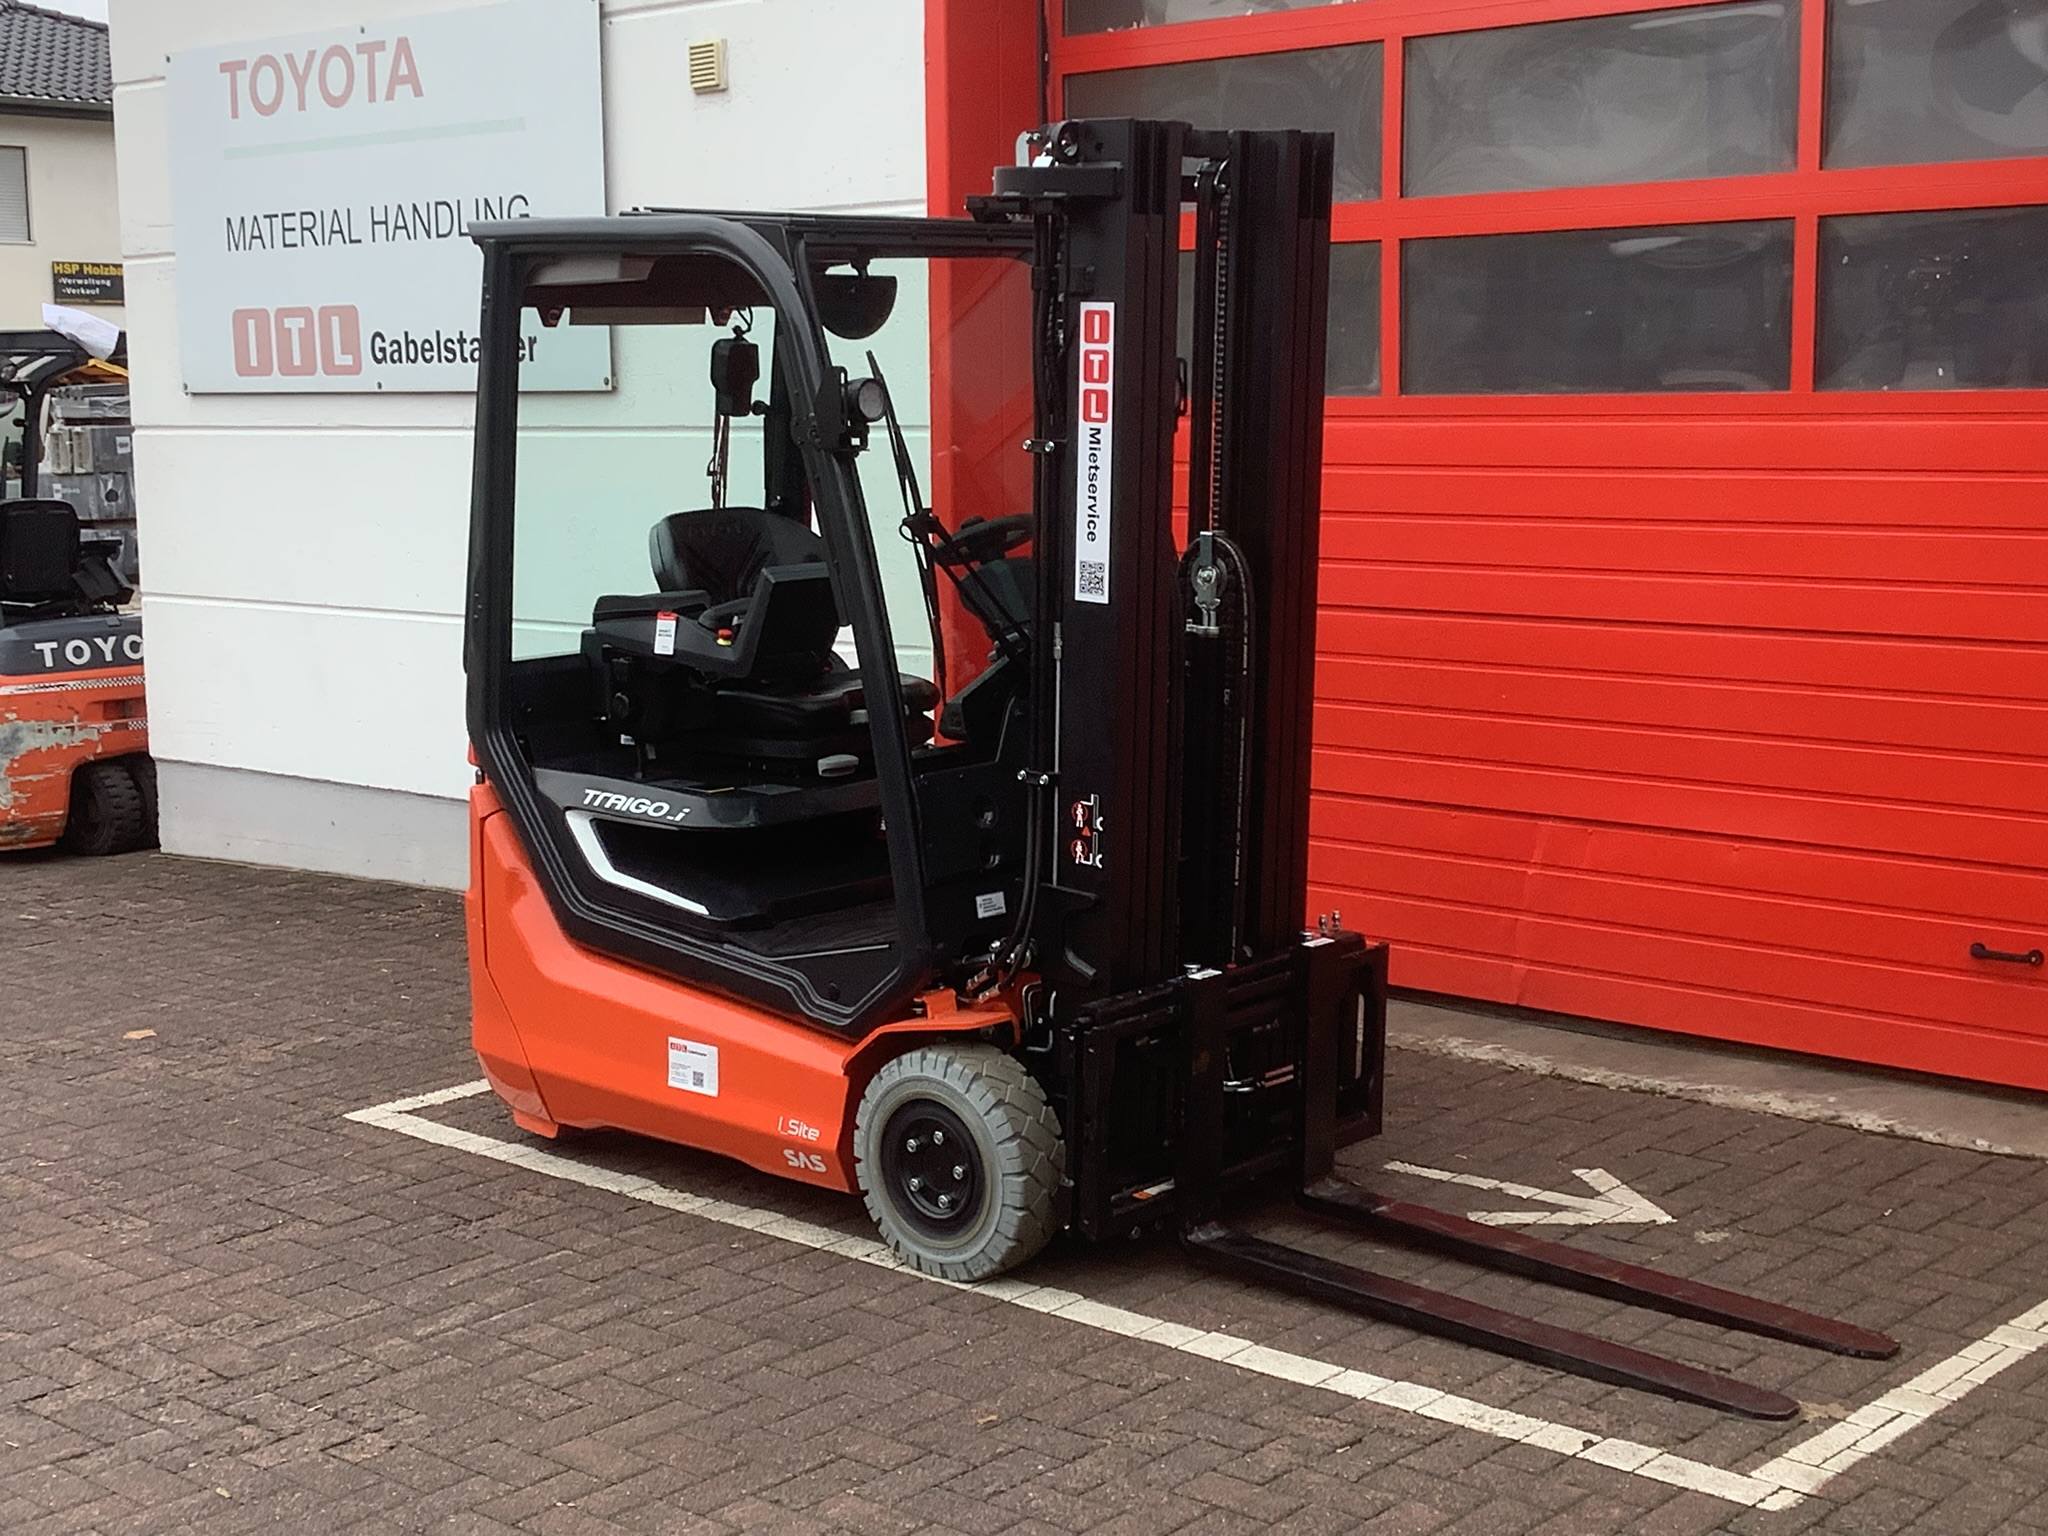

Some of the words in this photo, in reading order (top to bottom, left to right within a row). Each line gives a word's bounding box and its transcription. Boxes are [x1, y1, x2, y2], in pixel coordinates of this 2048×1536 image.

[219, 36, 424, 119] TOYOTA
[226, 207, 362, 252] MATERIAL
[370, 194, 530, 243] HANDLING
[53, 263, 79, 274] HSP
[242, 309, 357, 371] ITL
[371, 330, 537, 364] Gabelstaer
[1086, 311, 1107, 421] ITL
[1087, 427, 1101, 542] Mietservice
[783, 1149, 827, 1172] SAS
